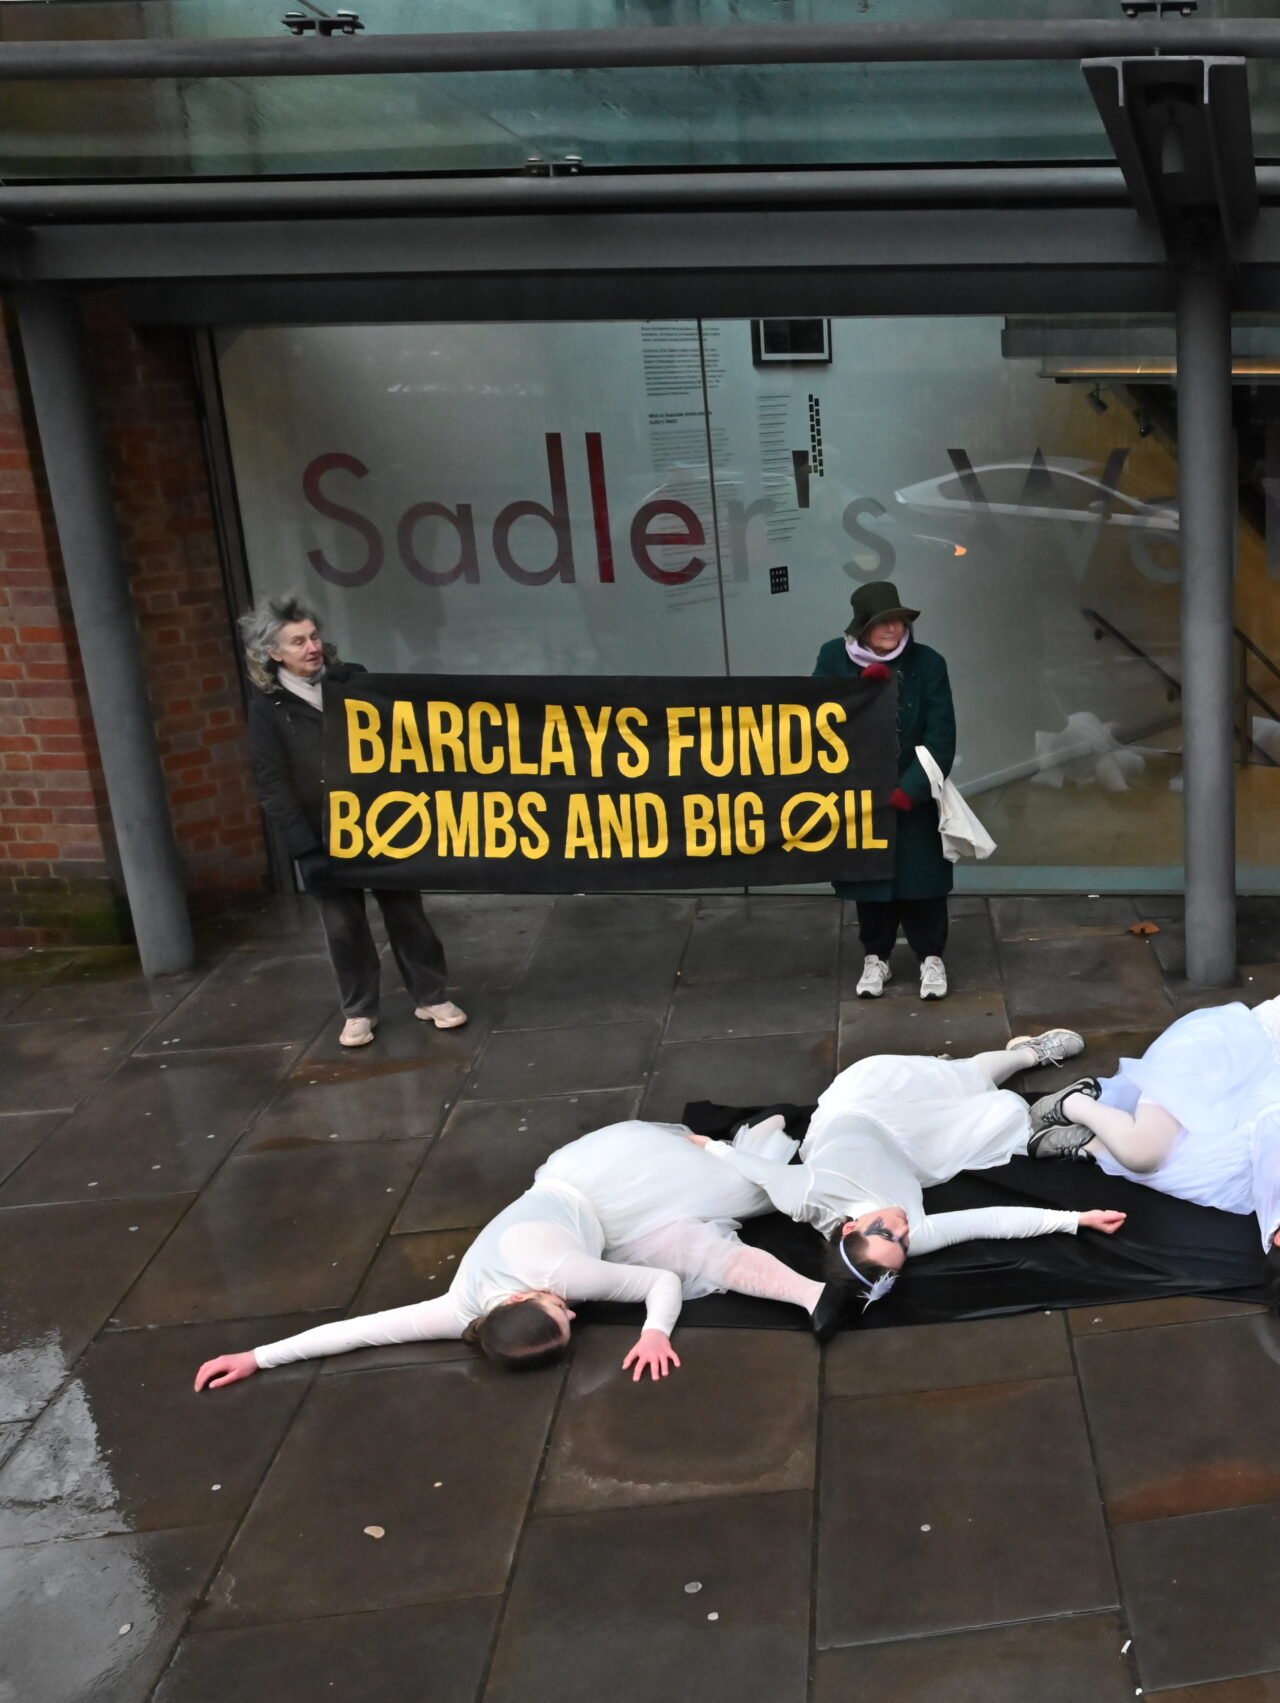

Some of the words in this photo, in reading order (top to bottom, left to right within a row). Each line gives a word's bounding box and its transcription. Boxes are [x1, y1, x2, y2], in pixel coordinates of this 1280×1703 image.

[302, 431, 897, 587] Sadler's
[344, 698, 650, 779] BARCLAYS
[666, 701, 850, 778] FUNDS
[565, 791, 669, 859] AND
[683, 791, 766, 858] BIG
